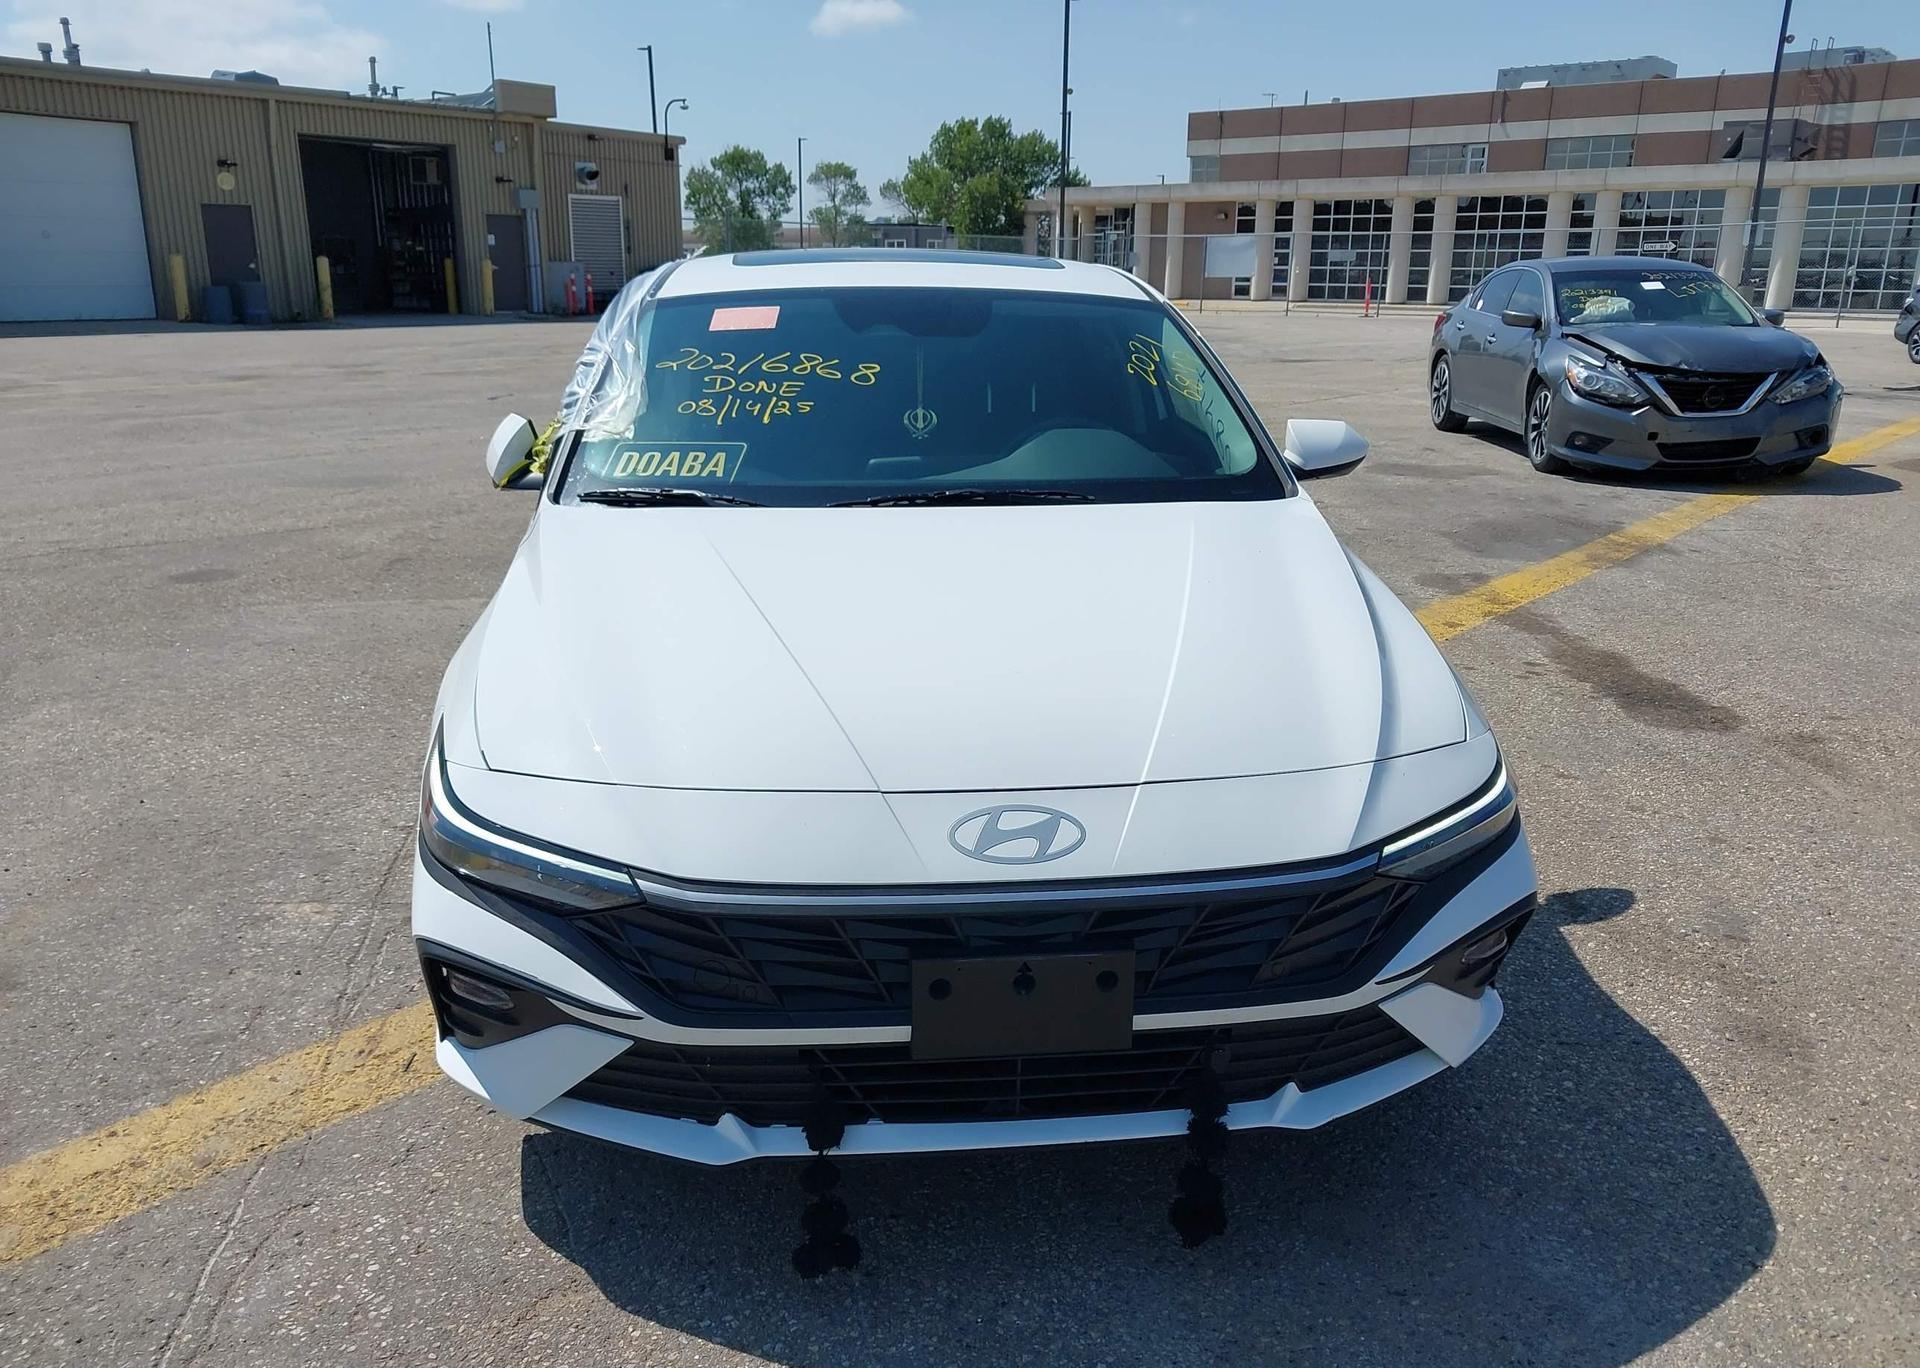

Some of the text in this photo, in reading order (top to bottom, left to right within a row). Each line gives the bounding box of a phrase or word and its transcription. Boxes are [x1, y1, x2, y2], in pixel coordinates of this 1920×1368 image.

[1127, 333, 1165, 386] 2021
[703, 375, 805, 397] DONE
[613, 451, 728, 478] DOABA
